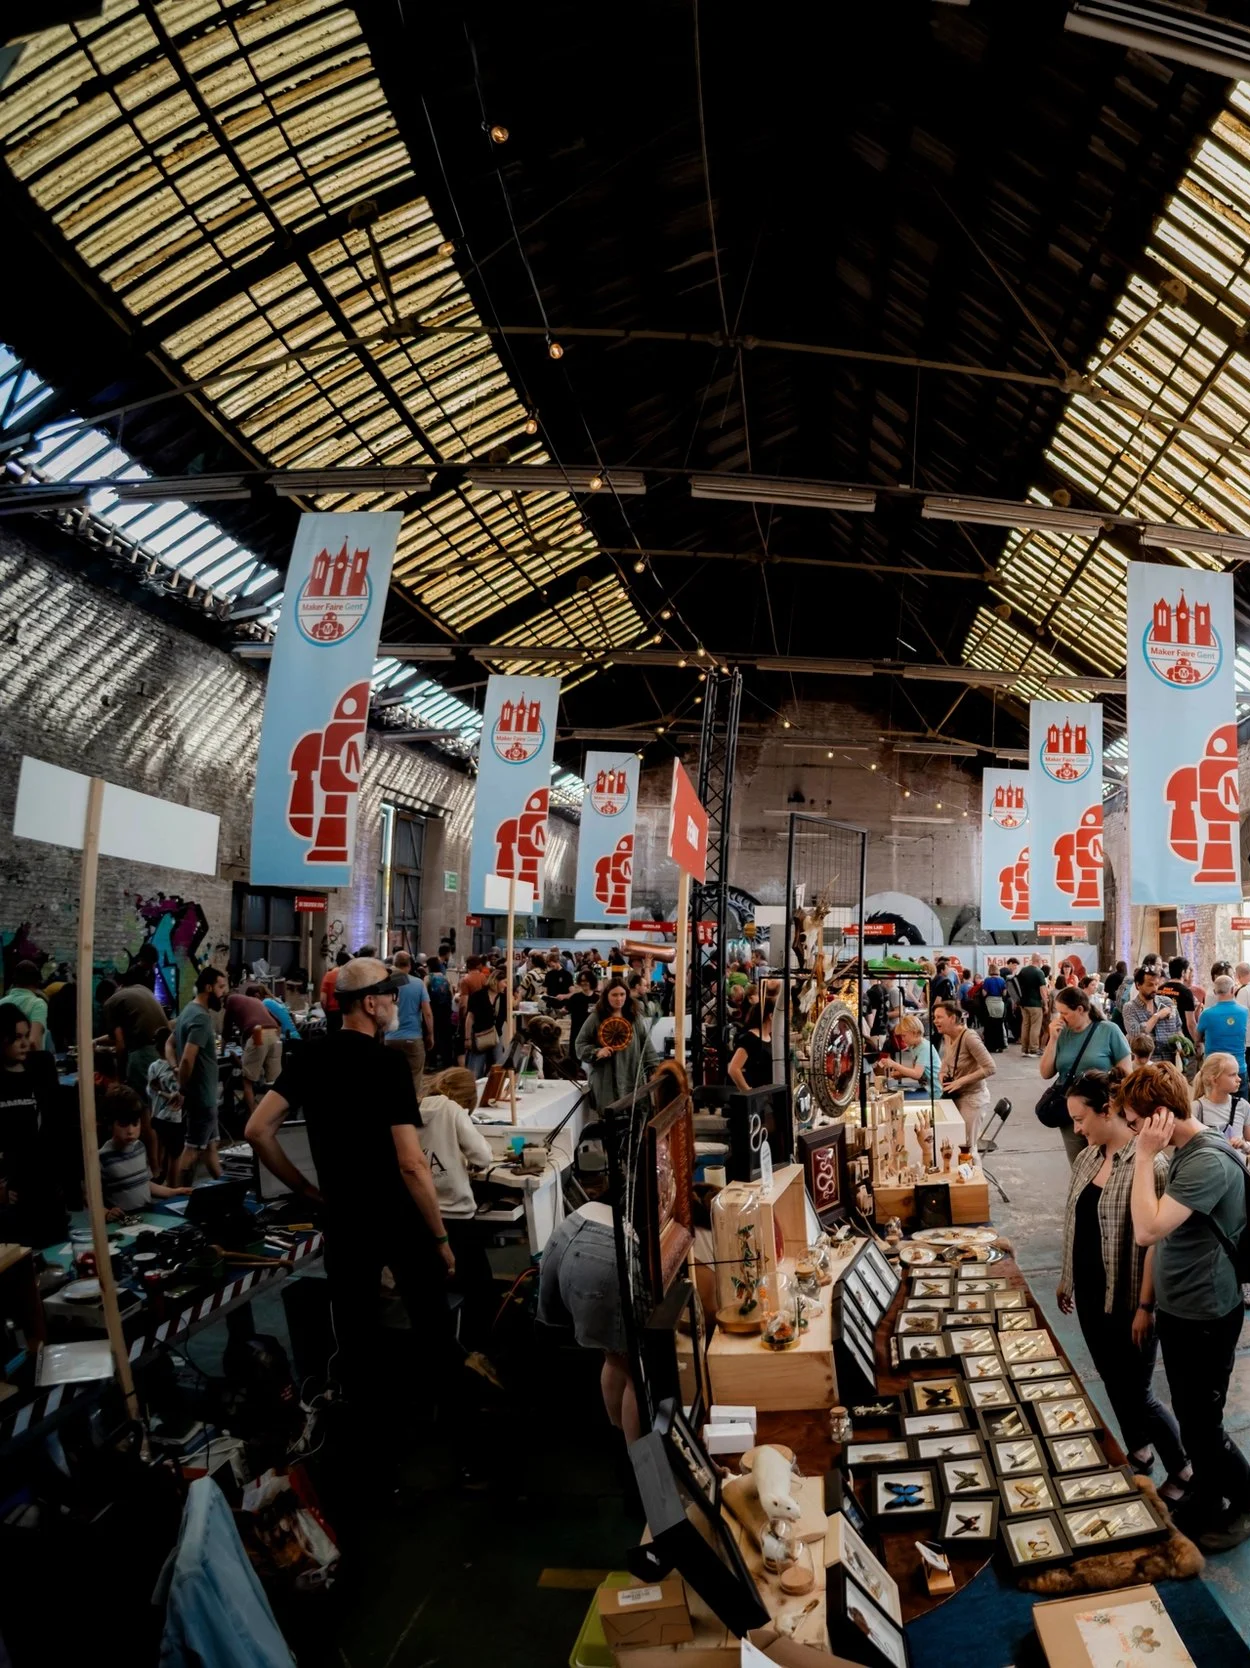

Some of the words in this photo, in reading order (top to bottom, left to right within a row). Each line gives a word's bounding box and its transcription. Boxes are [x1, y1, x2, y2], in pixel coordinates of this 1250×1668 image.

[302, 603, 324, 611] Maker
[325, 602, 344, 611] Faire
[344, 602, 363, 610] Gent
[1150, 647, 1175, 656] Maker
[1176, 649, 1196, 658] Faire
[1197, 652, 1215, 660] Gent
